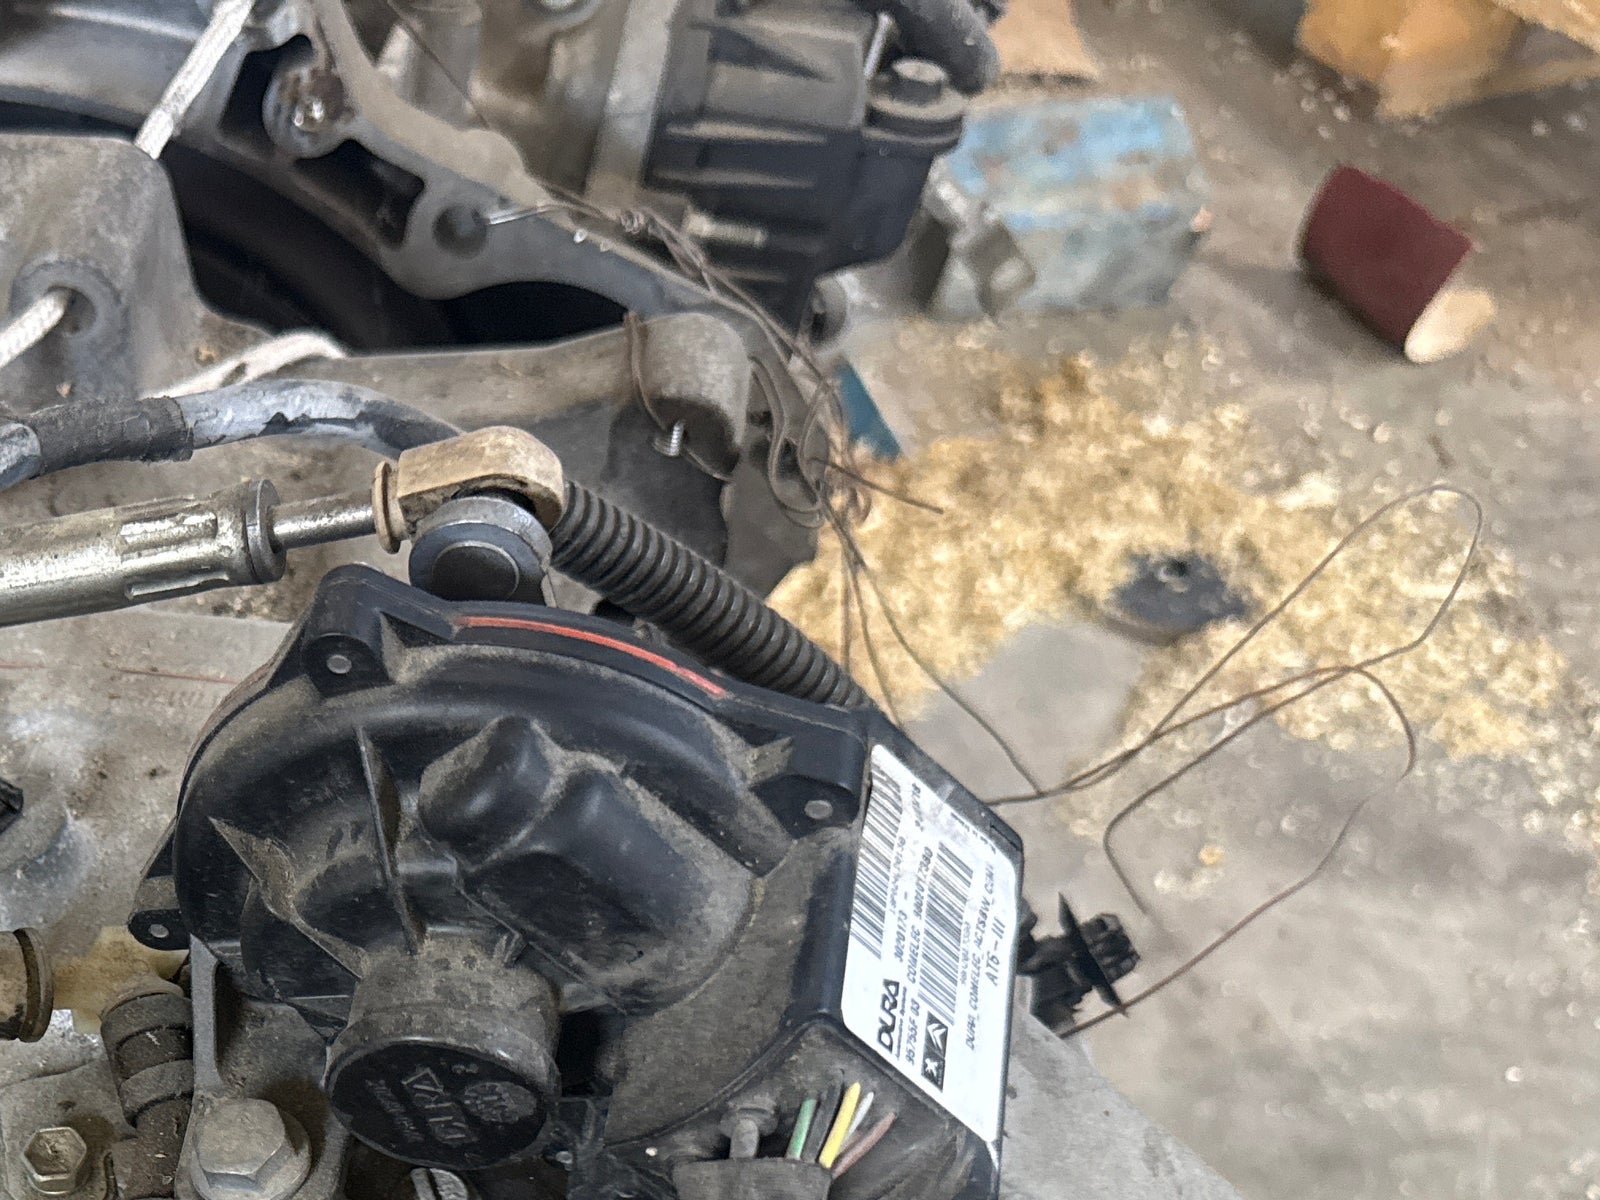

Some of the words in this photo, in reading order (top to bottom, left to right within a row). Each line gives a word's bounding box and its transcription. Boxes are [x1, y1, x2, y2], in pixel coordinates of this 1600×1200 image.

[906, 925, 920, 983] COMELEC
[985, 951, 999, 985] AT6
[877, 979, 899, 1052] DURA
[910, 998, 920, 1016] 03
